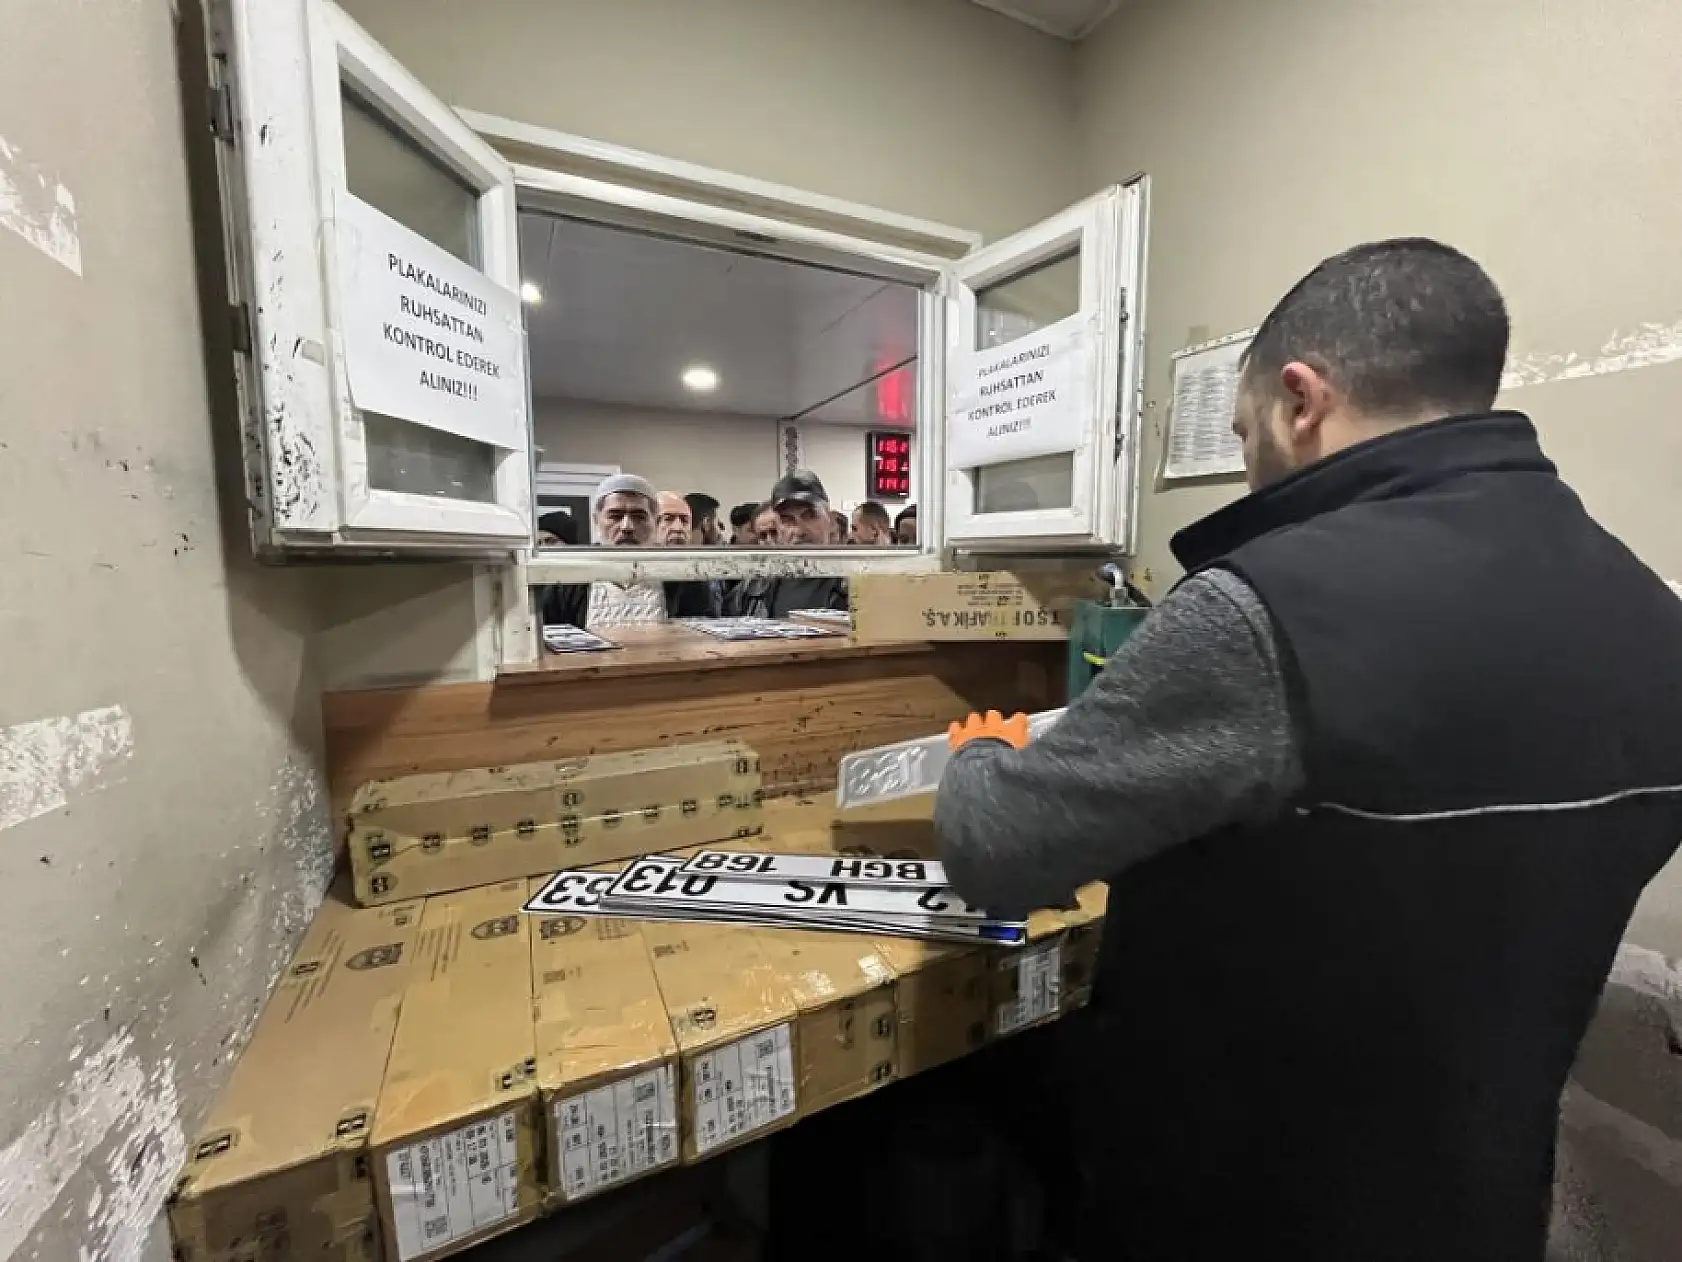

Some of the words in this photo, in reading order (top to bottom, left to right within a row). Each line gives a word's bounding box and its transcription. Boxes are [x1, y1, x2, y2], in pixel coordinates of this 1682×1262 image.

[388, 252, 487, 316] PLAKALARINIZI
[400, 295, 483, 343] RUHSATTAN
[383, 322, 454, 363] KONTROL
[456, 349, 500, 379] EDEREK
[419, 369, 478, 401] ALINIZ!!!
[980, 369, 1044, 397] RUHSATTAN
[968, 400, 1016, 421] KONTROL
[1017, 389, 1056, 409] EDEREK
[694, 853, 778, 873] 168
[830, 860, 926, 880] BGH
